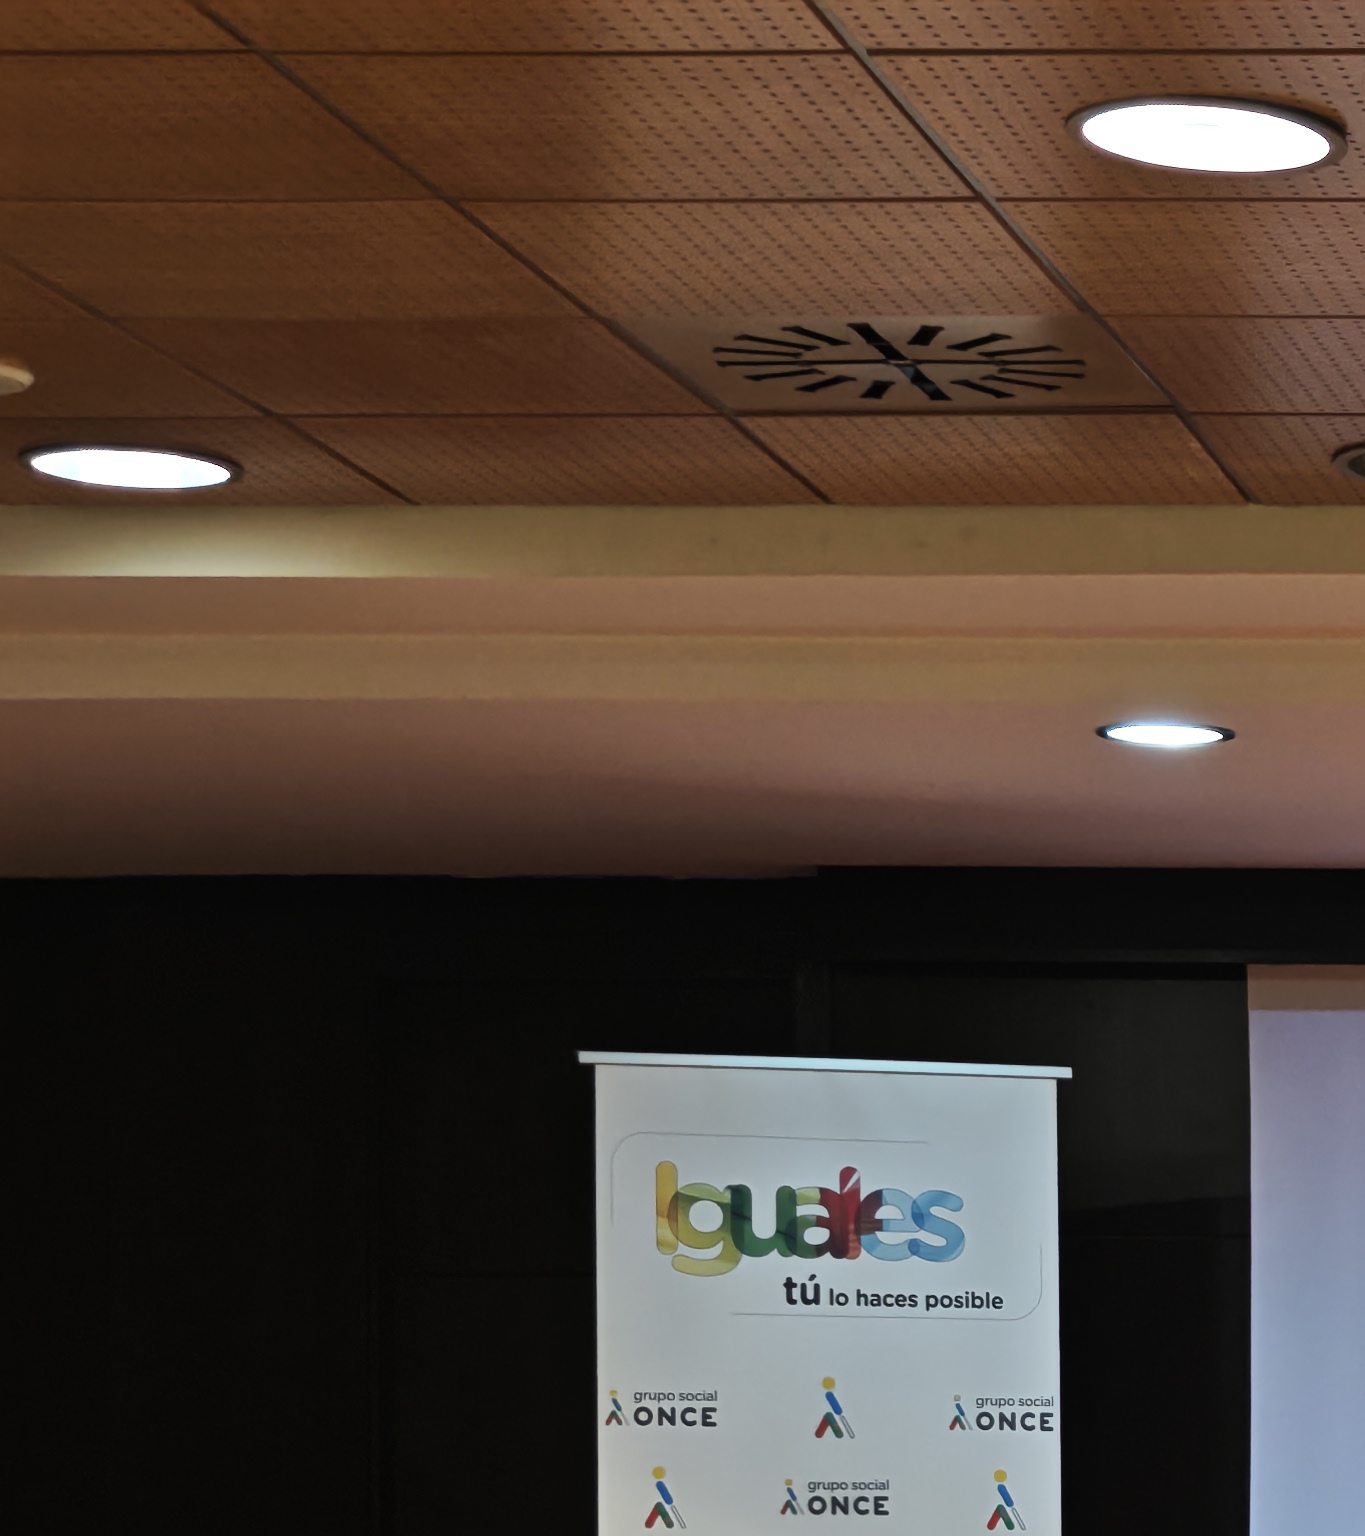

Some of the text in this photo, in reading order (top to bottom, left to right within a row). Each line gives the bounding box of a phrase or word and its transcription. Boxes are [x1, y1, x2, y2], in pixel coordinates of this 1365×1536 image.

[655, 1161, 965, 1276] Iguales
[783, 1274, 1003, 1311] tú lo haces posible
[634, 1389, 717, 1403] grupo social
[976, 1395, 1053, 1408] grupo social
[634, 1407, 717, 1427] ONCE
[976, 1412, 1053, 1431] ONCE
[808, 1479, 889, 1493] grupo social
[808, 1496, 889, 1515] ONCE
